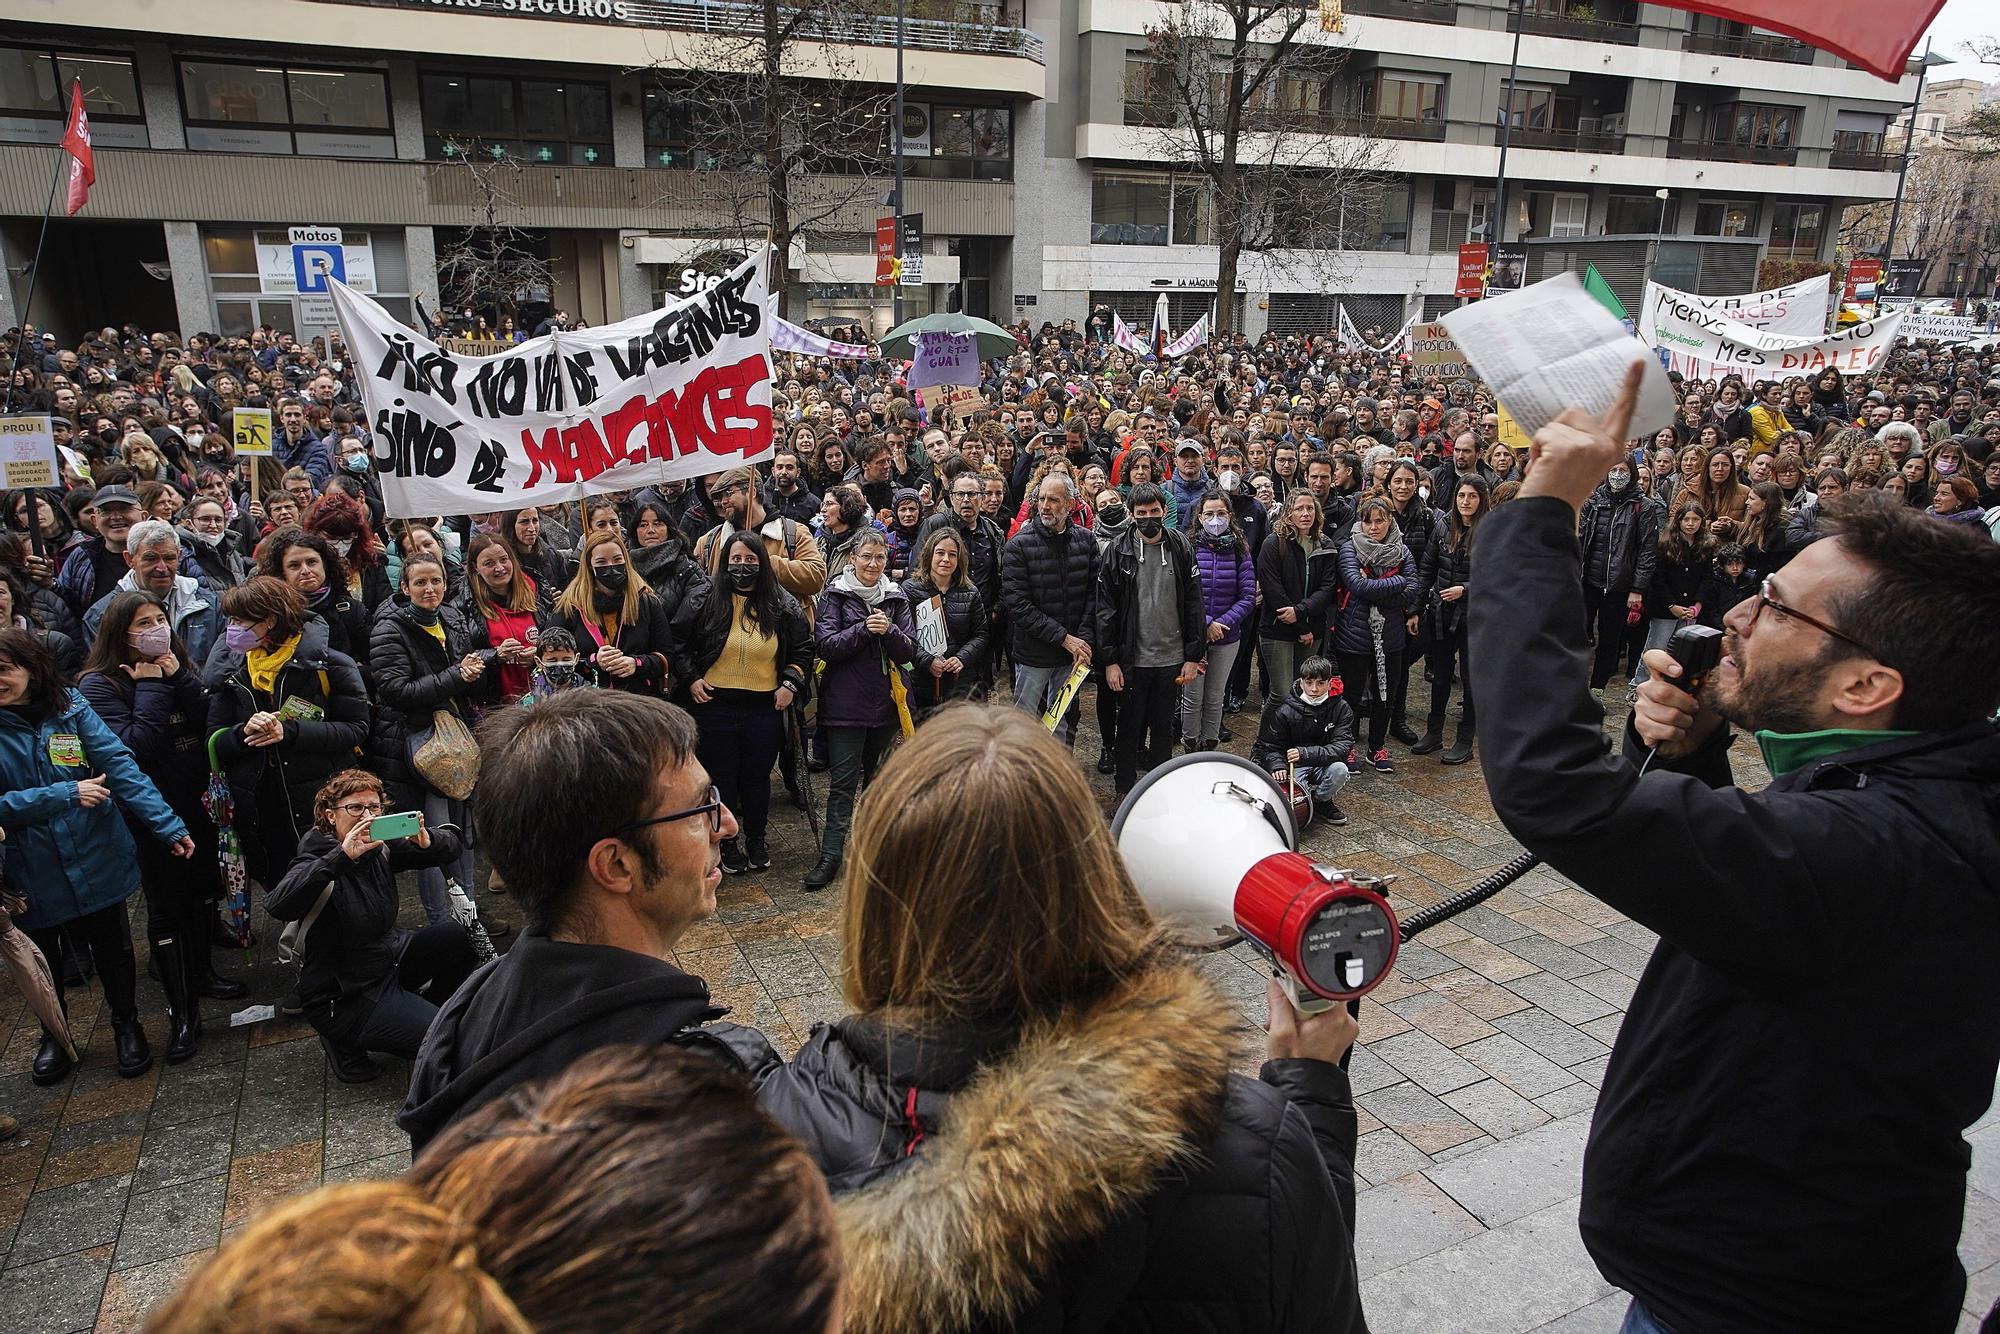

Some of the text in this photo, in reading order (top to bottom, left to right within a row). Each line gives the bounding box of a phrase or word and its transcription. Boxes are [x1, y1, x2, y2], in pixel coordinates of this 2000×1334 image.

[294, 230, 337, 242] Motos
[302, 250, 334, 287] P
[1178, 278, 1187, 287] LA
[1189, 277, 1218, 287] MÀQUIN
[1656, 292, 1727, 337] Menys
[1427, 326, 1448, 338] NO
[924, 345, 969, 357] NO ETS
[1413, 339, 1458, 354] IMPOSICION
[466, 357, 528, 419] NO
[534, 351, 564, 413] VA
[563, 351, 603, 406] DE
[3, 424, 34, 433] PROU
[375, 354, 774, 493] SINÓ DE MANCANCES
